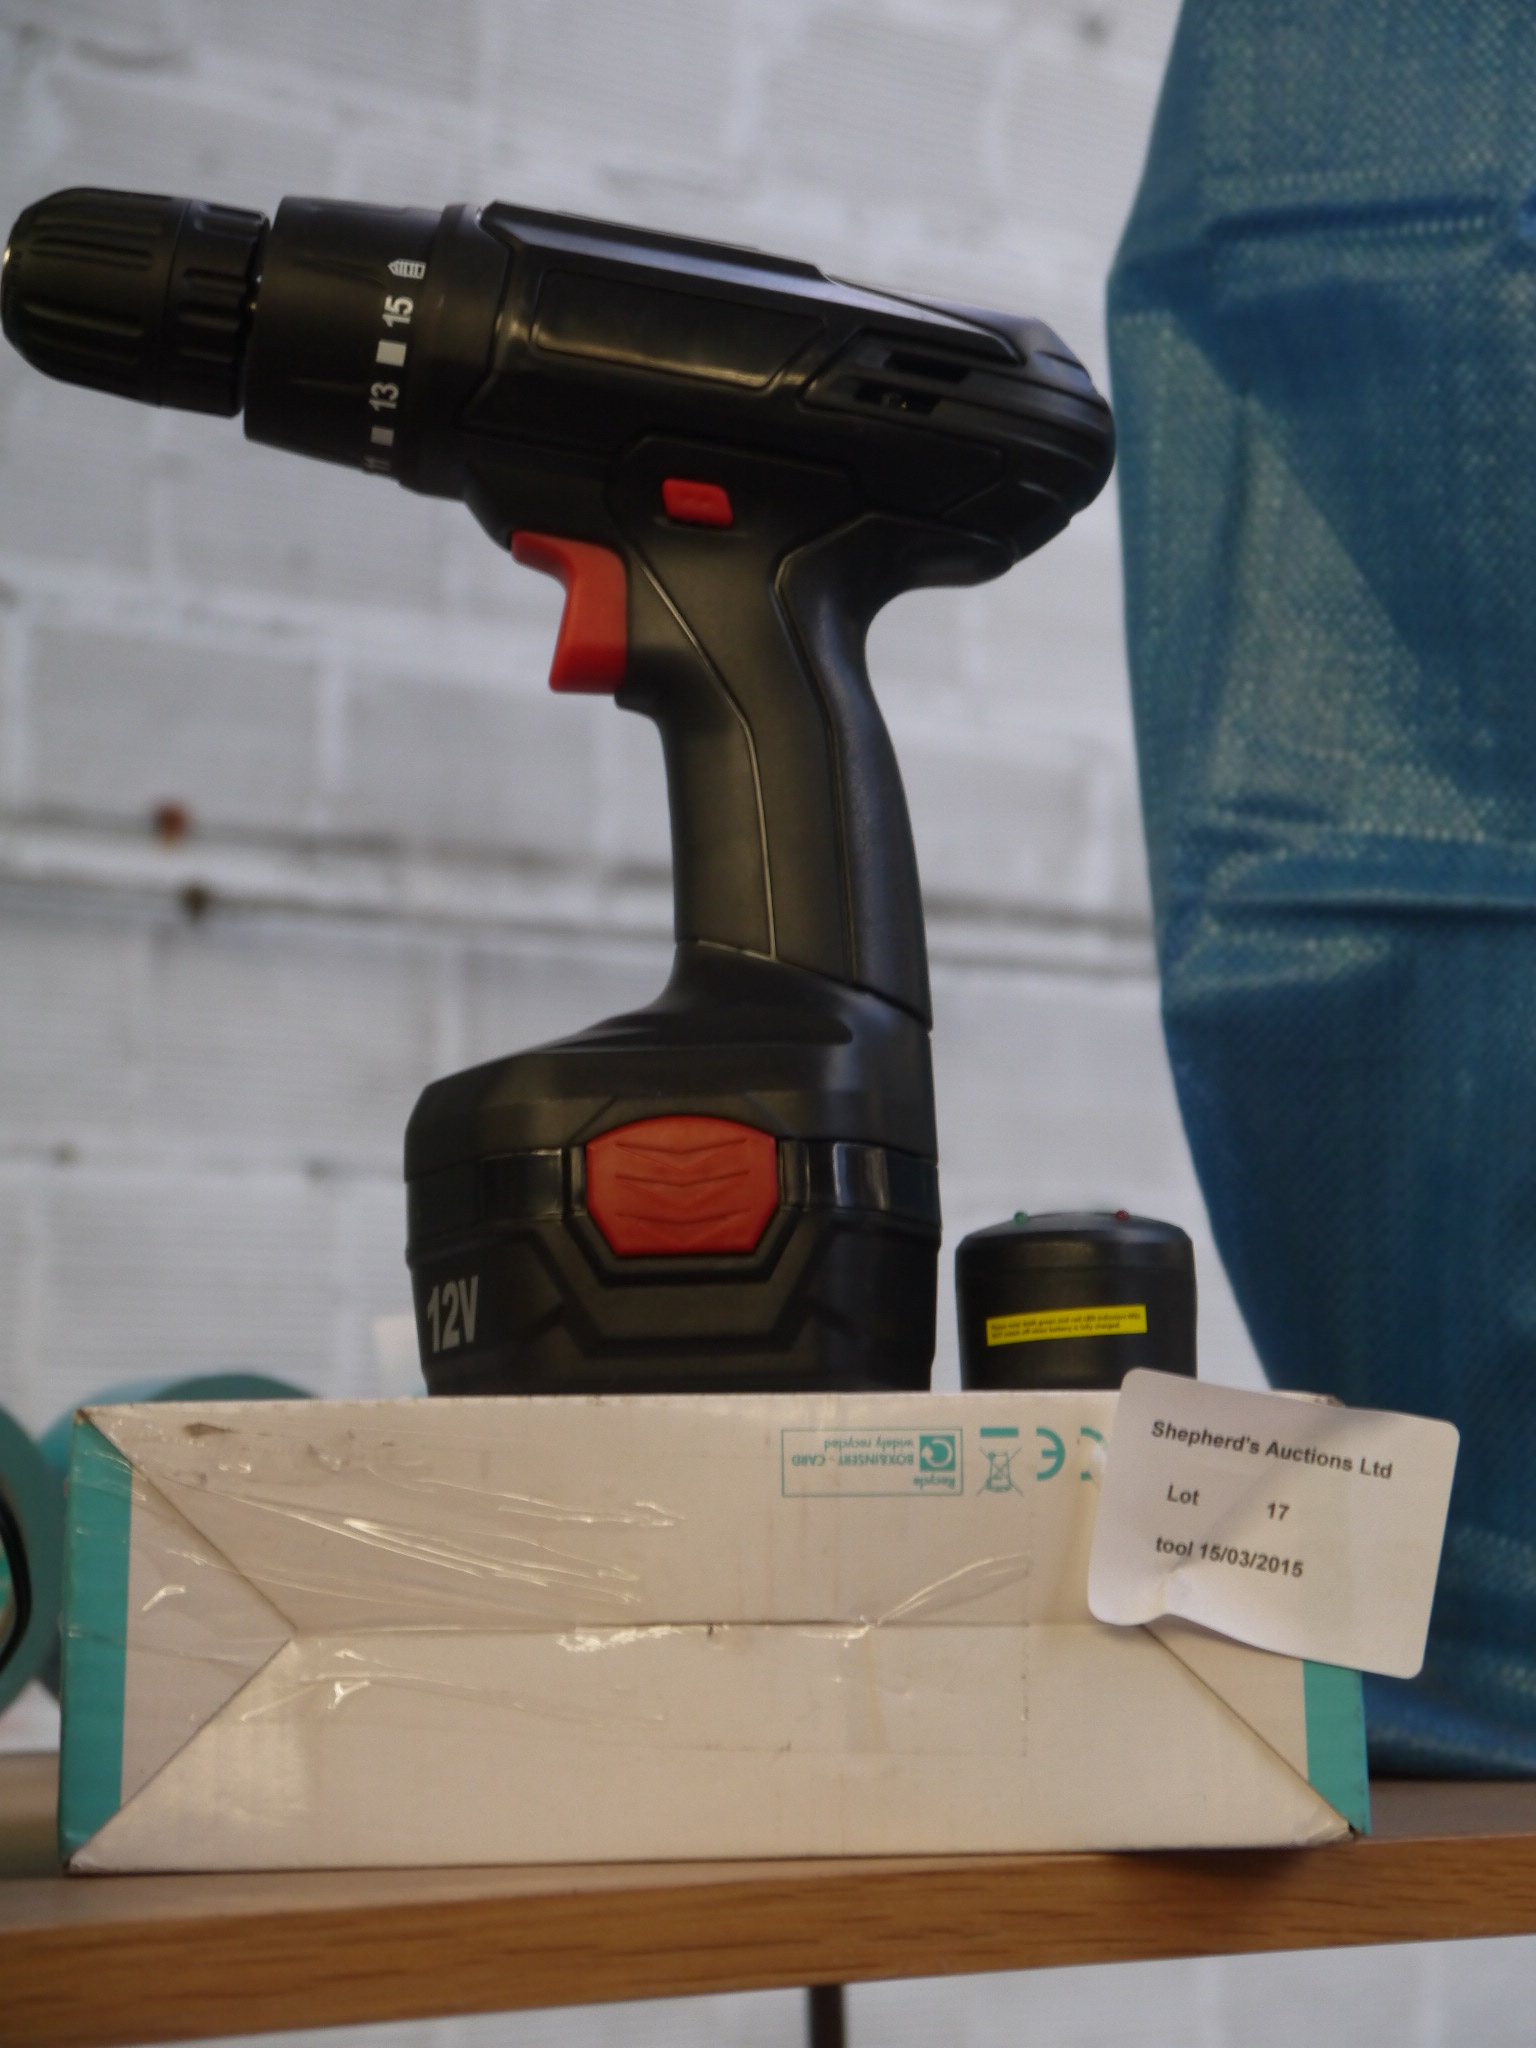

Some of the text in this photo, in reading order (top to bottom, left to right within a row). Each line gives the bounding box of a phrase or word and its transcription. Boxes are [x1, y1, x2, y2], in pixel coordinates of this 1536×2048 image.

[382, 295, 414, 328] 15
[369, 382, 399, 412] 13
[427, 1275, 479, 1353] 12V
[791, 1455, 826, 1467] CARD
[824, 1435, 914, 1452] widely recycled
[1151, 1419, 1393, 1480] Shepherd's Auctions Ltd
[1167, 1484, 1290, 1521] Lot 17
[1155, 1536, 1304, 1578] tool 15/03/2015
